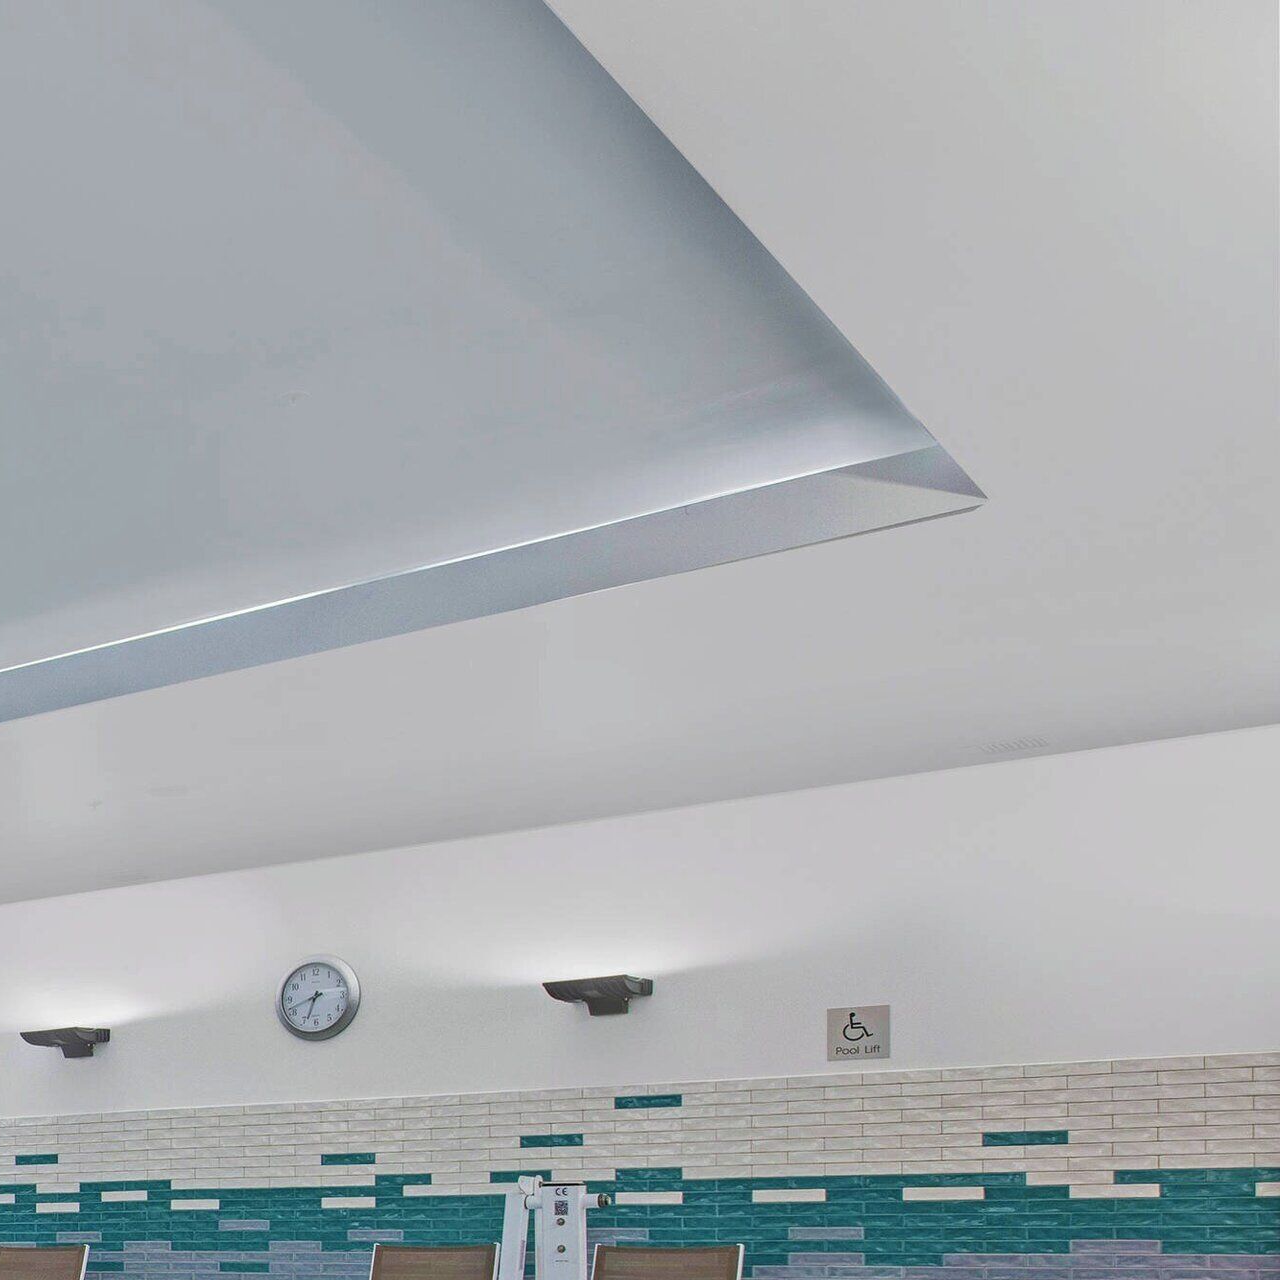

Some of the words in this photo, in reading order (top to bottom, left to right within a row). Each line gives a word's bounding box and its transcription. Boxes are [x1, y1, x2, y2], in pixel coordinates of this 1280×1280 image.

[291, 983, 299, 991] 10
[836, 1046, 860, 1055] Pool
[865, 1044, 881, 1053] Lift
[556, 1188, 568, 1196] CE
